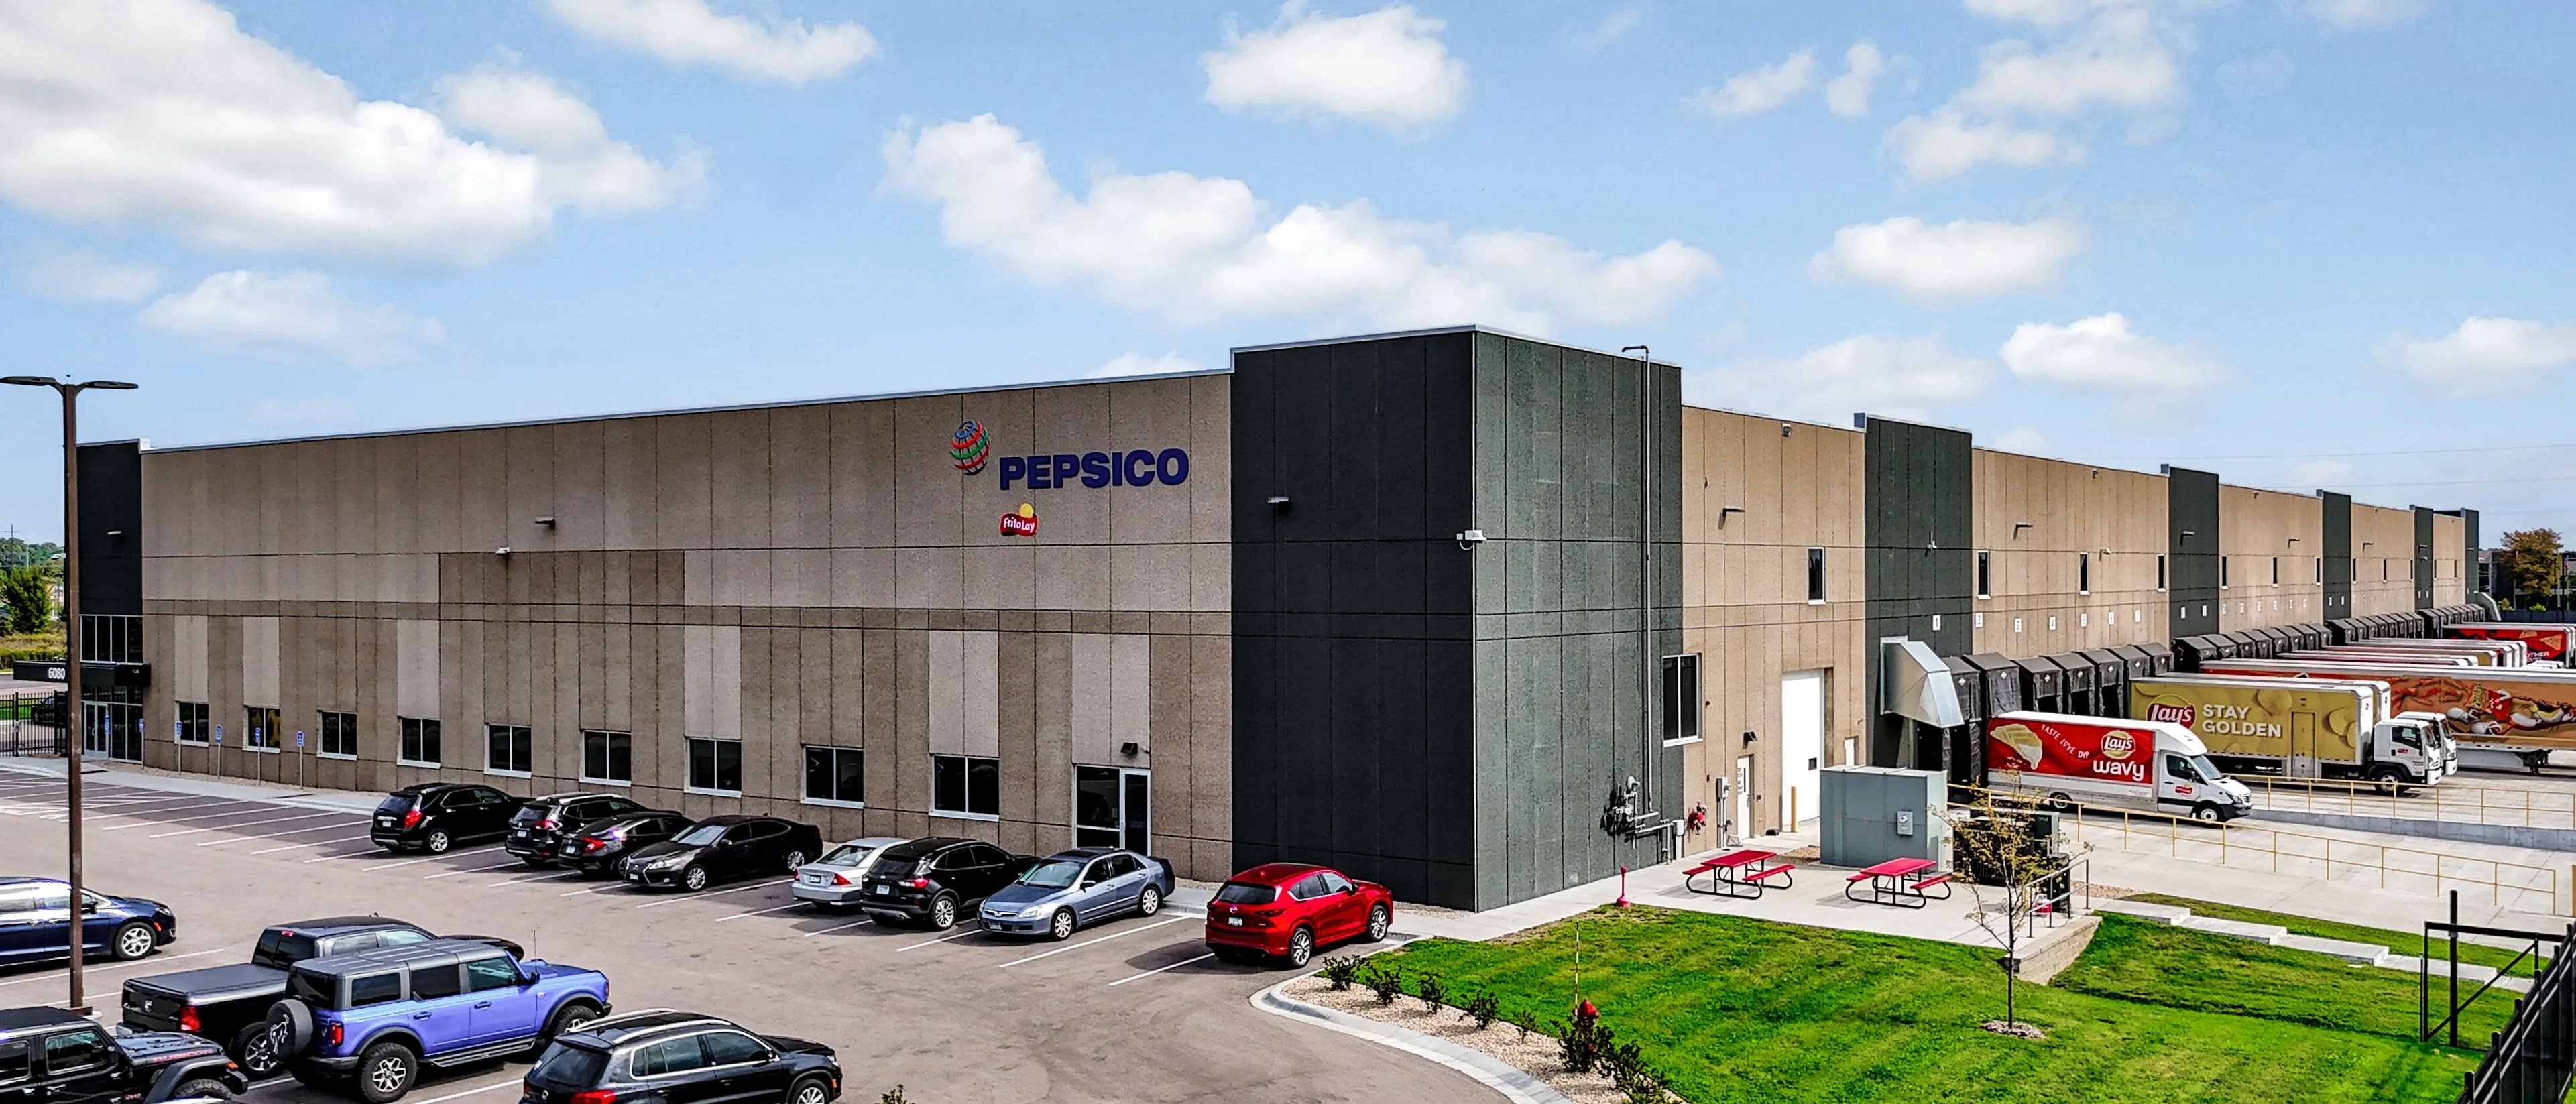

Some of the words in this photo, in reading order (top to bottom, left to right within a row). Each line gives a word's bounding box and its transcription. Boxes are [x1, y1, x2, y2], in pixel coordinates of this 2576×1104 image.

[999, 448, 1189, 491] PEPSICO
[48, 667, 66, 680] 6080
[2202, 704, 2249, 719] STAY
[2202, 720, 2281, 737] GOLDEN
[2104, 735, 2133, 751] Lay's
[2093, 759, 2144, 782] wavy
[153, 1048, 213, 1063] RUBICON
